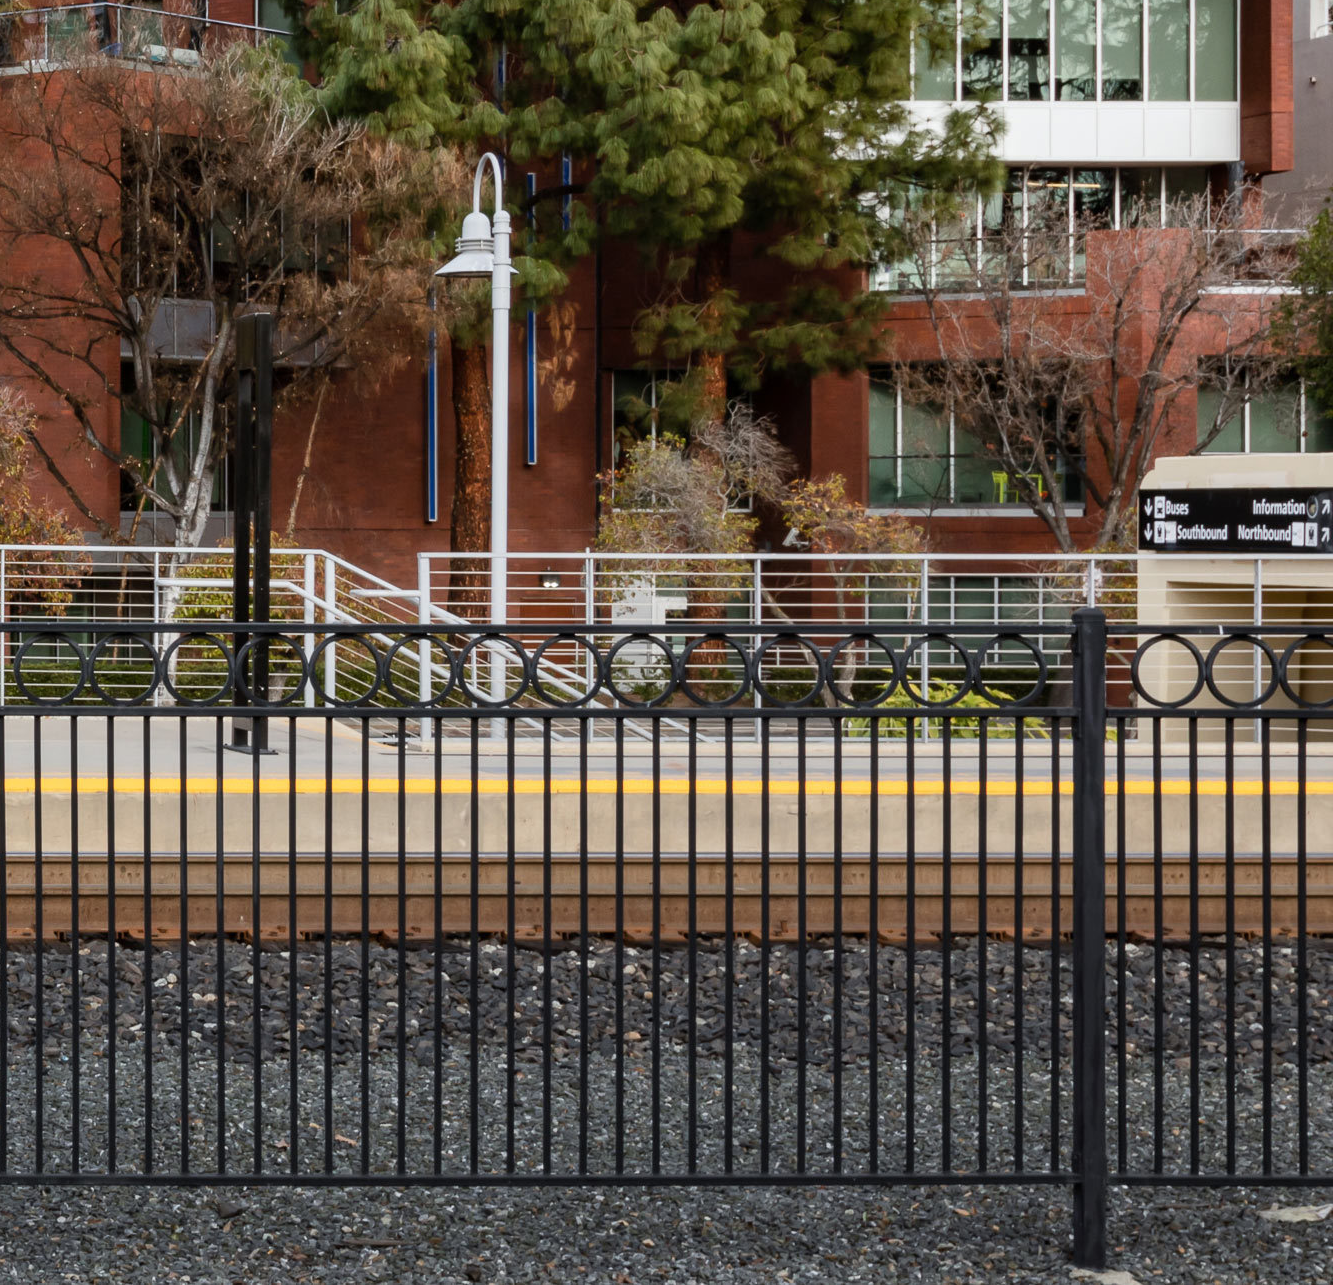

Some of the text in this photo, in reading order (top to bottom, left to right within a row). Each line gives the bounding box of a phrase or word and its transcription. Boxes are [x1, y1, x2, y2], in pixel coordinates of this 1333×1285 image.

[1165, 500, 1190, 516] Buses
[1252, 498, 1307, 516] Information
[1176, 524, 1229, 541] Southbound
[1237, 524, 1292, 542] Northbound
